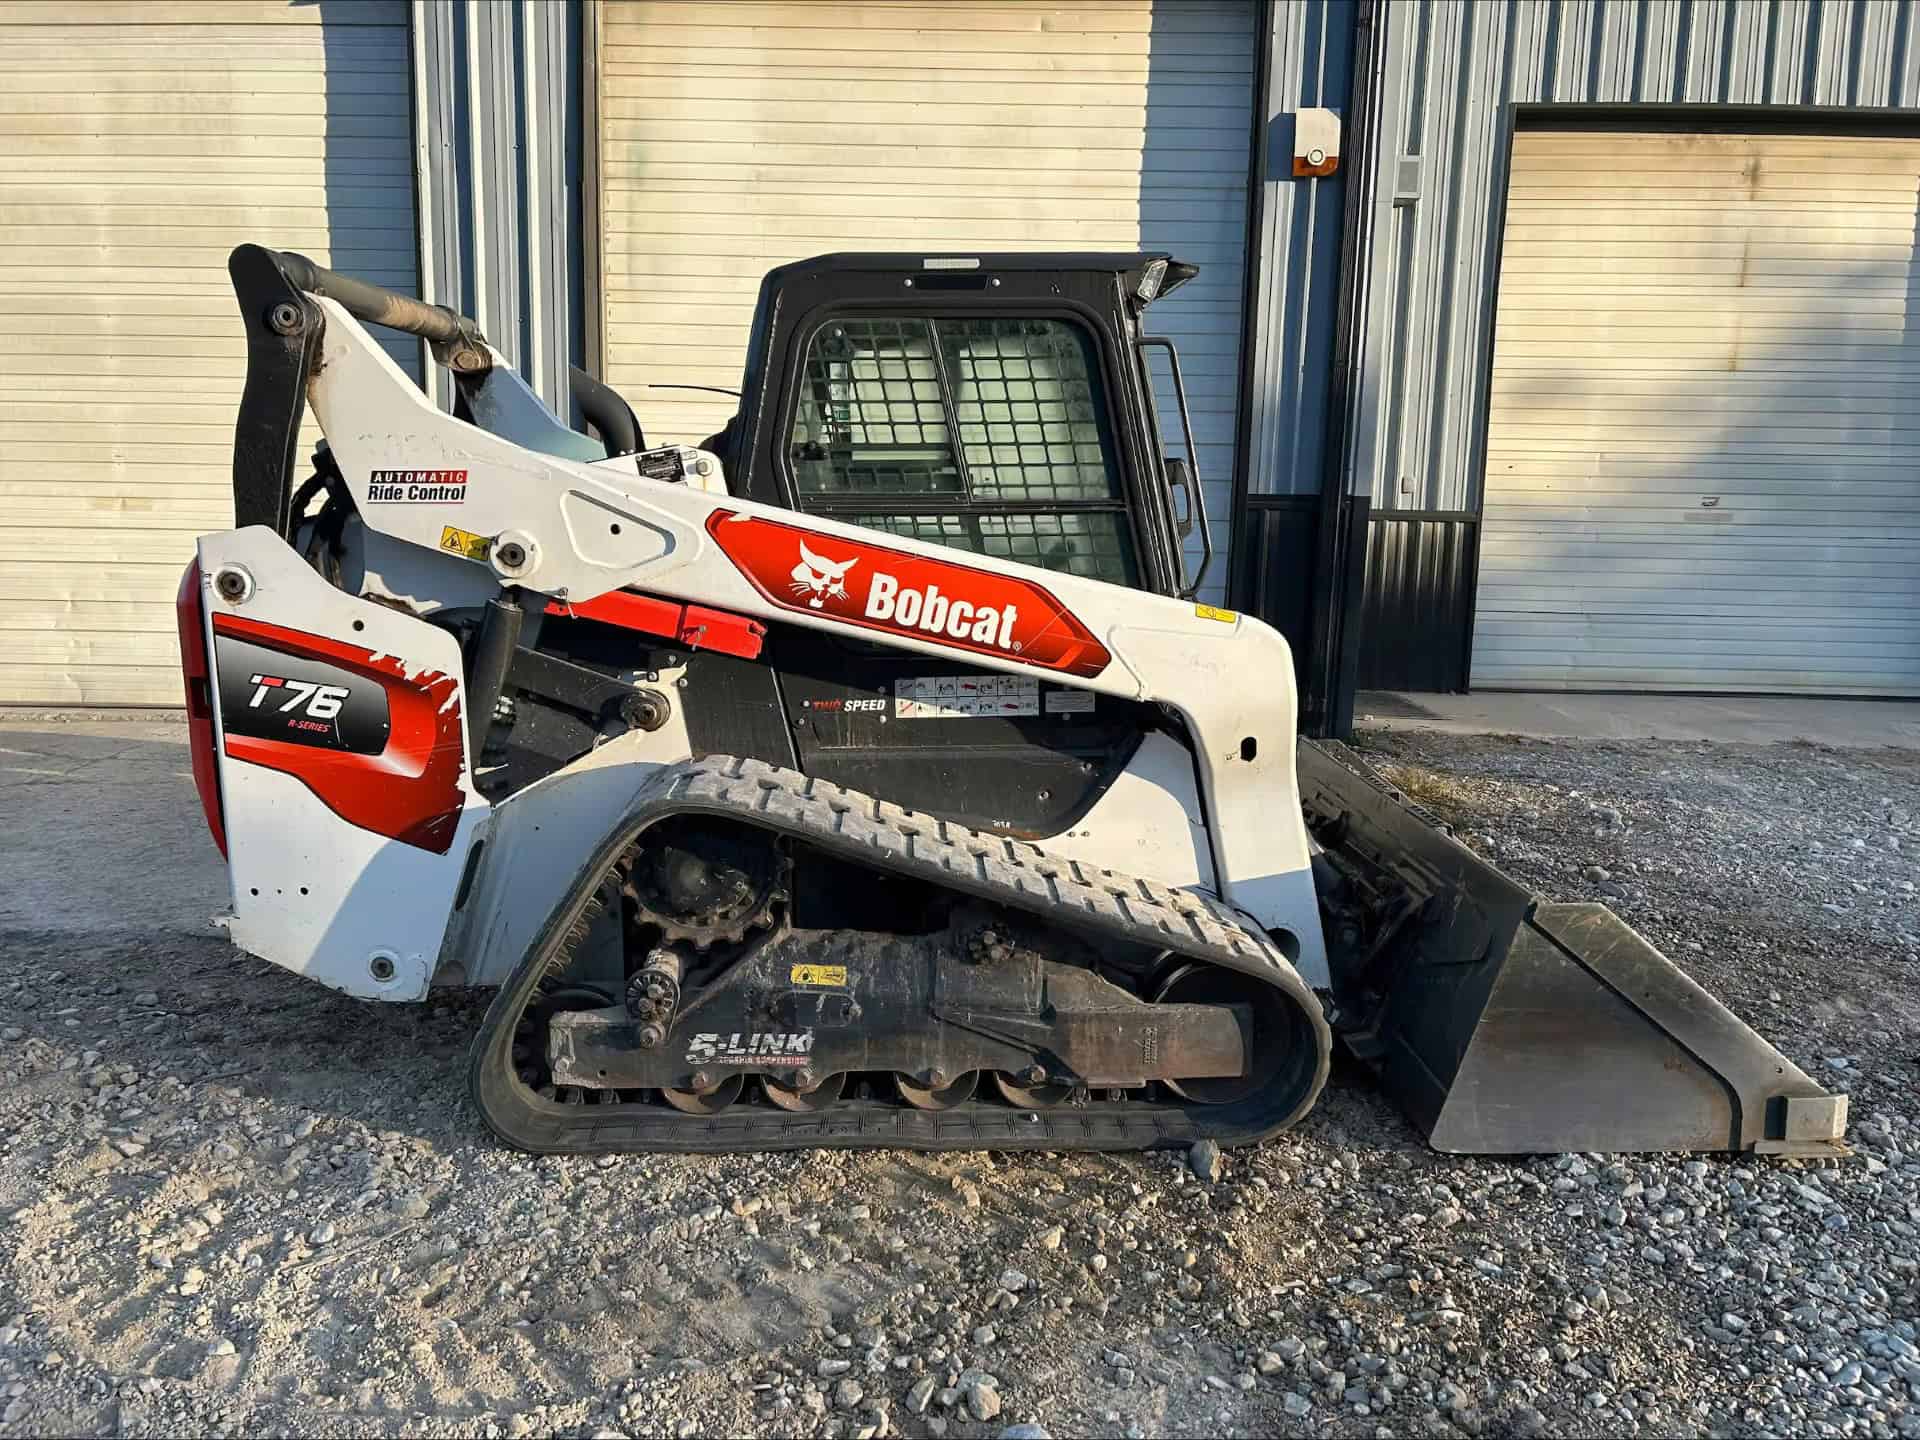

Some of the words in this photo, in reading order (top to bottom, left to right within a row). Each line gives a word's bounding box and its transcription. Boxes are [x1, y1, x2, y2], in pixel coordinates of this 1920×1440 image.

[374, 471, 464, 482] AUTOMATIC
[368, 485, 403, 500] Ride
[408, 485, 466, 500] Control
[865, 572, 1018, 649] Bobcat
[249, 674, 350, 719] T76
[844, 699, 886, 711] SPEED
[287, 719, 331, 733] R-SERIES
[685, 1033, 812, 1064] 5-LINK
